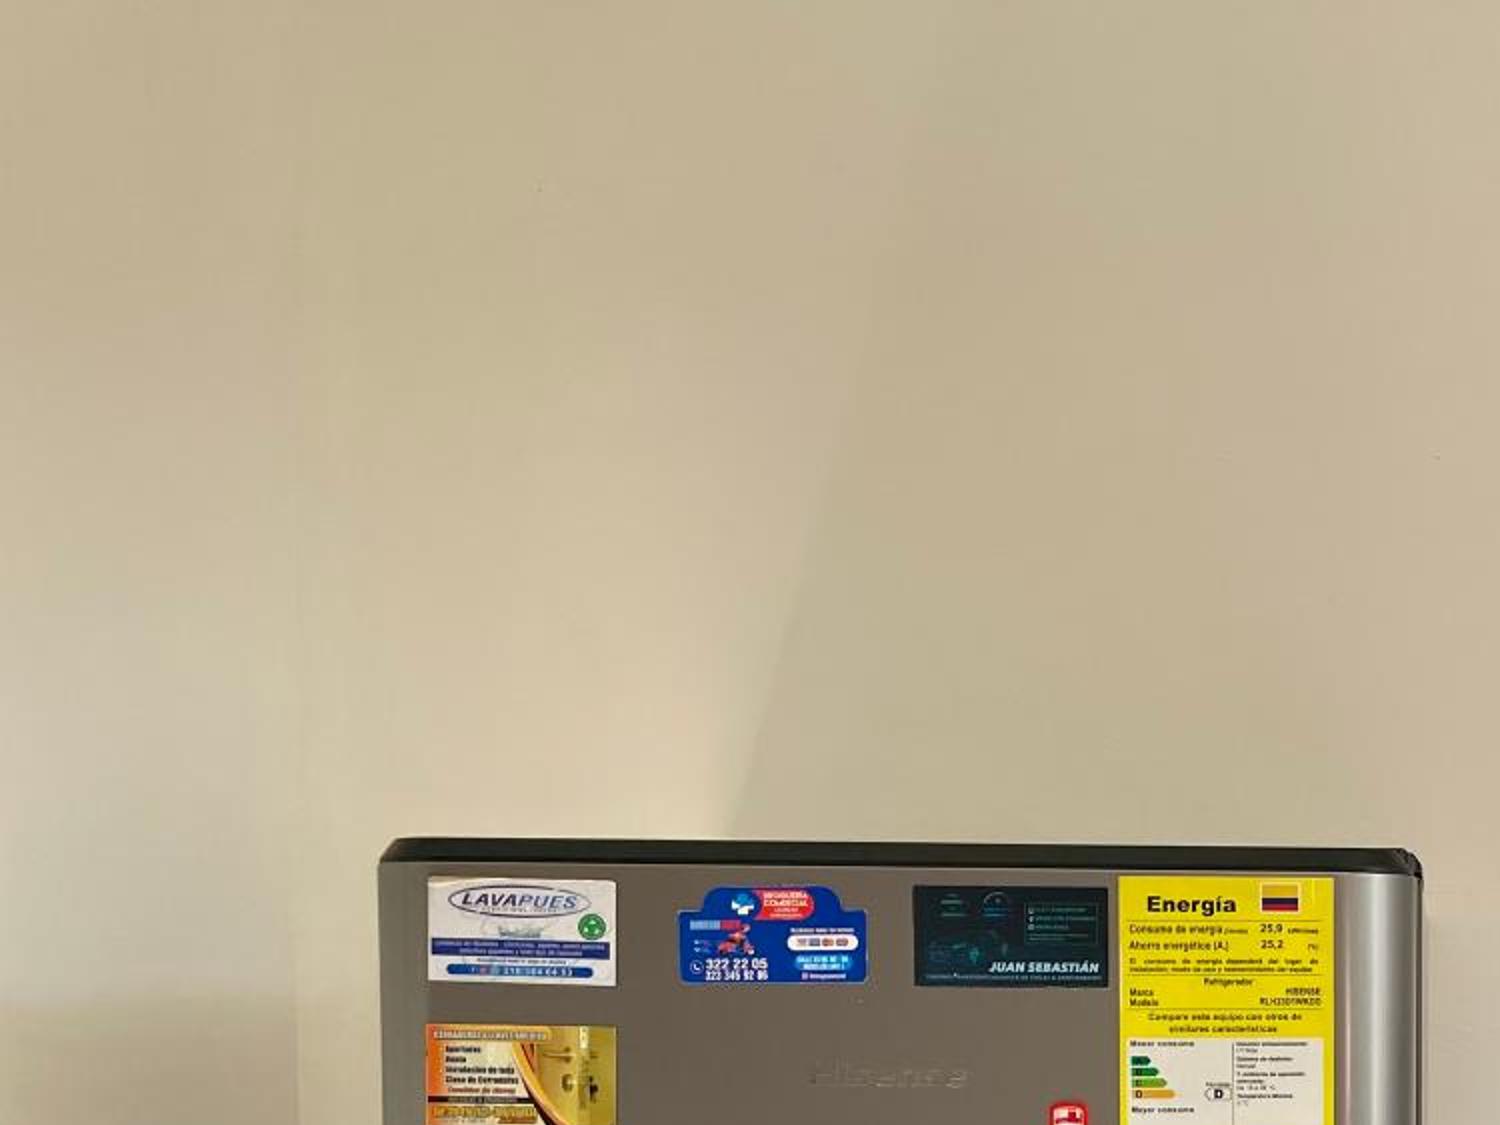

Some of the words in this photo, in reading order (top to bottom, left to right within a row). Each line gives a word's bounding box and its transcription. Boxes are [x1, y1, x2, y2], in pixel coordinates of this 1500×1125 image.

[461, 893, 578, 909] LAVAPUES
[1146, 895, 1237, 916] Energía
[1175, 924, 1187, 934] de
[988, 961, 1026, 974] JUAN
[1028, 959, 1100, 974] SEBASTIÁN
